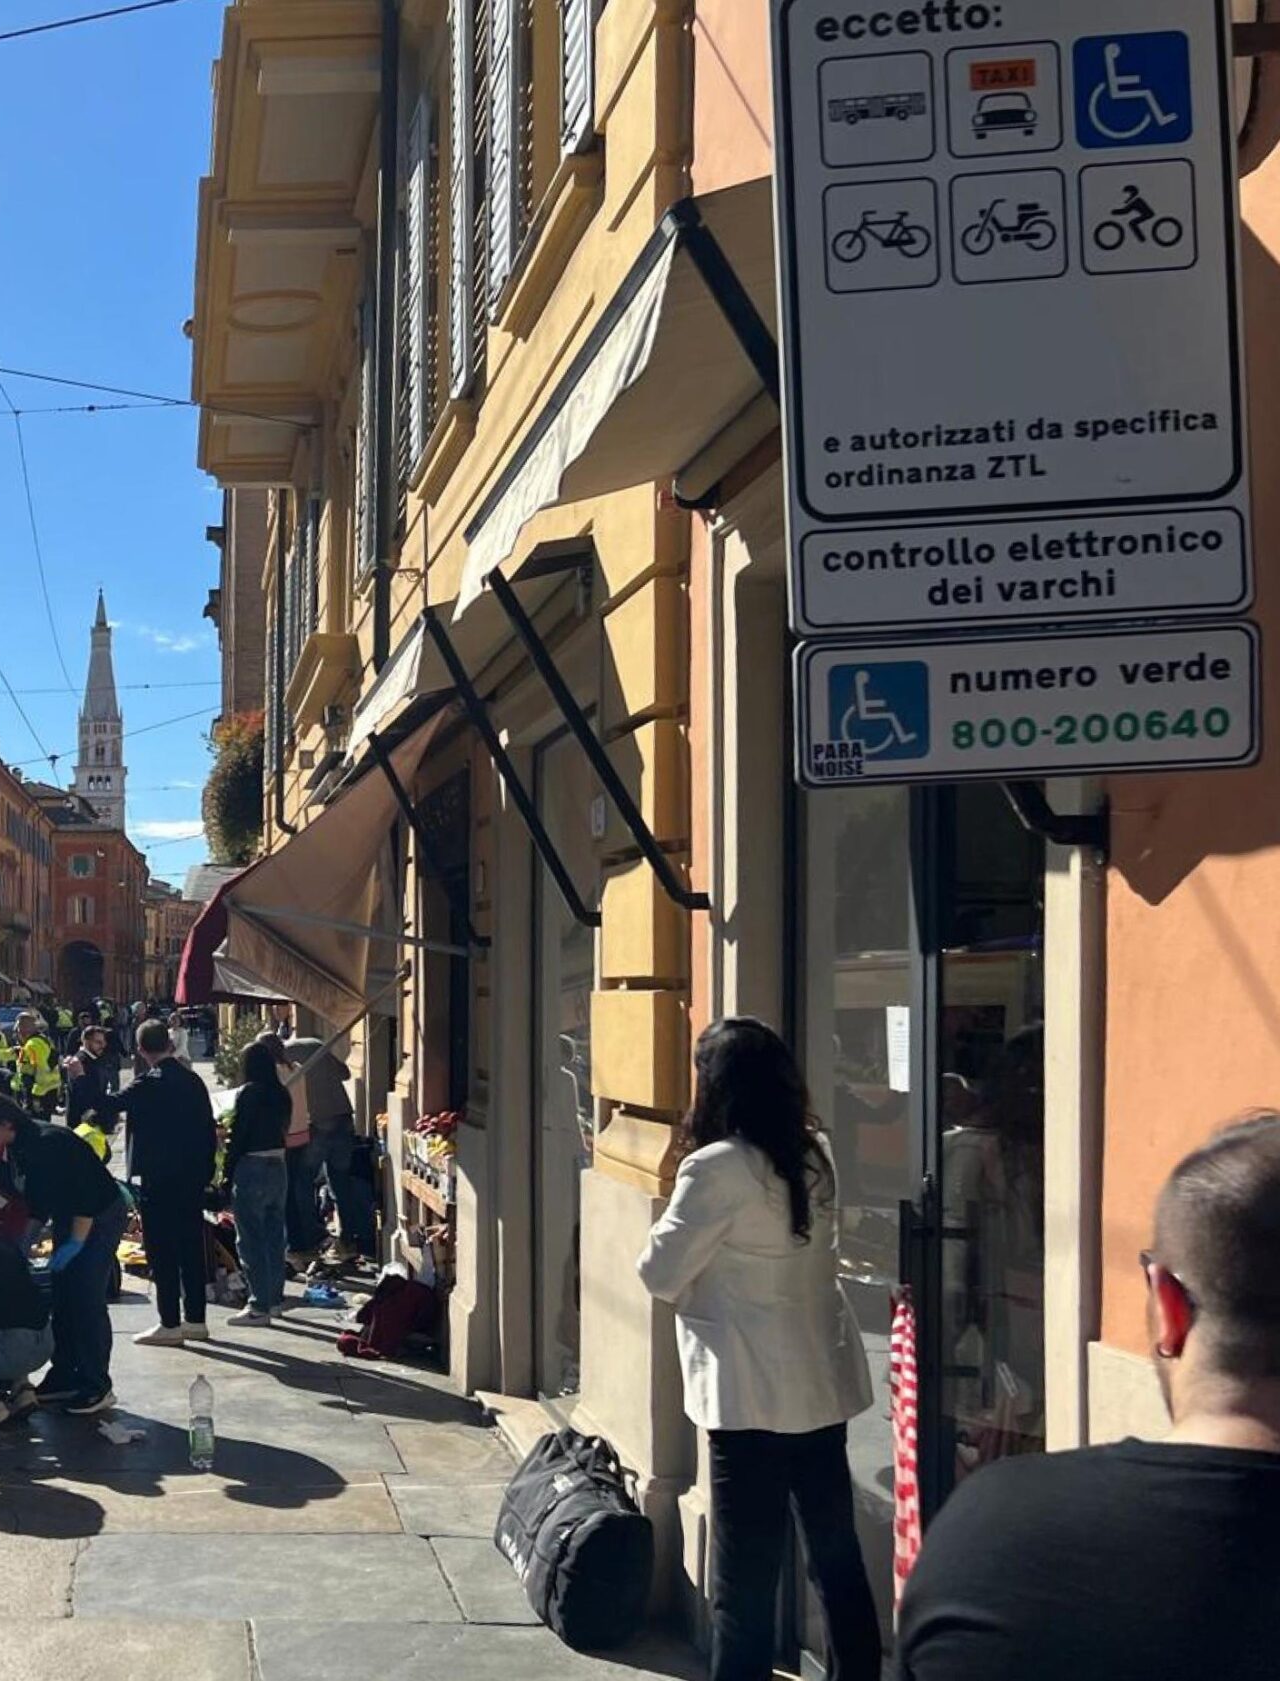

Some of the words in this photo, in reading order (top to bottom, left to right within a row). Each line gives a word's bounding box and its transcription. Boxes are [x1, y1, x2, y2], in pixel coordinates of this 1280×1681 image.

[815, 0, 1002, 41] eccetto:
[976, 67, 1031, 87] TAXI
[823, 434, 841, 453] e
[850, 419, 1015, 452] autorizzati
[1027, 416, 1064, 441] da
[1075, 409, 1218, 442] specifica
[825, 461, 976, 488] ordinanza
[987, 453, 1046, 480] ZTL
[822, 536, 996, 572] controllo
[1008, 526, 1222, 563] elettronico
[927, 575, 983, 606] dei
[997, 568, 1116, 602] varchi
[950, 665, 1097, 694] numero
[1120, 653, 1232, 685] verde
[951, 707, 1231, 750] 800-200640
[813, 743, 863, 760] PARA
[813, 760, 864, 777] NOISE
